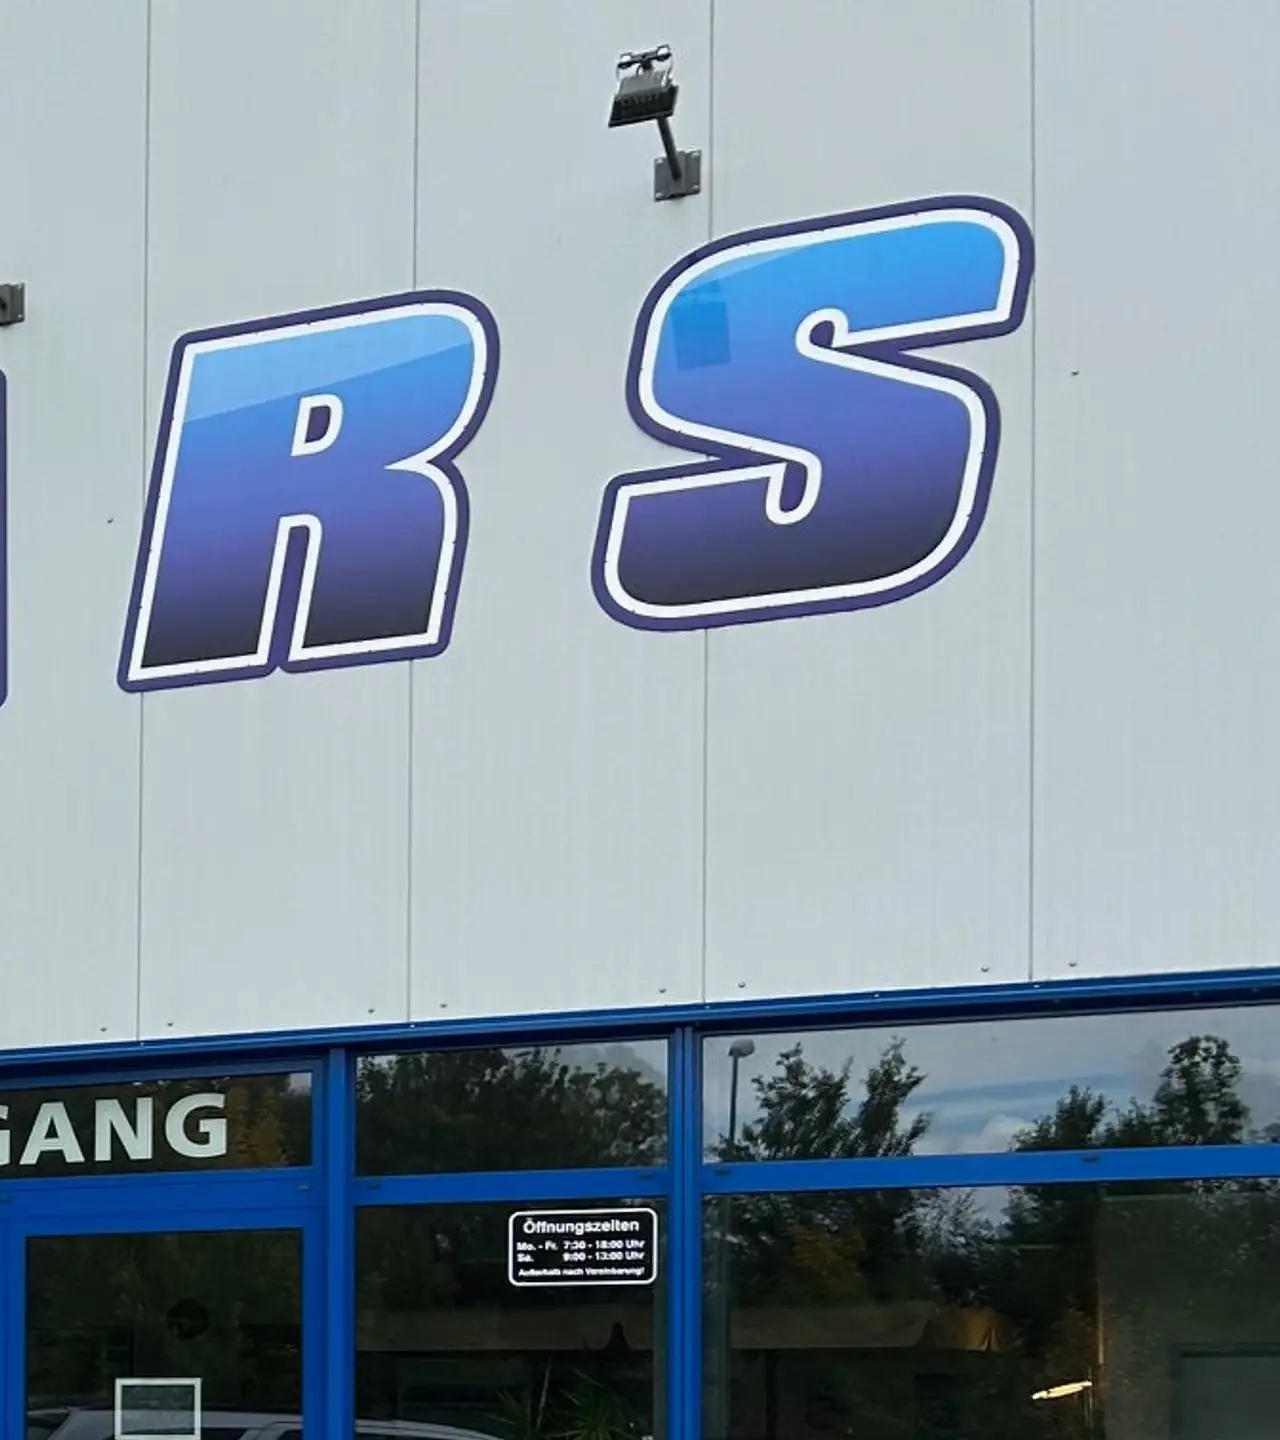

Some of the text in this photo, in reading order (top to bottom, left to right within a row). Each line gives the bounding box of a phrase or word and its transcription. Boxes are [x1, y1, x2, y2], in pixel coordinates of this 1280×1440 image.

[523, 1217, 640, 1235] Öffnungszeiten
[625, 1239, 646, 1249] Uhr
[625, 1251, 646, 1260] Uhr
